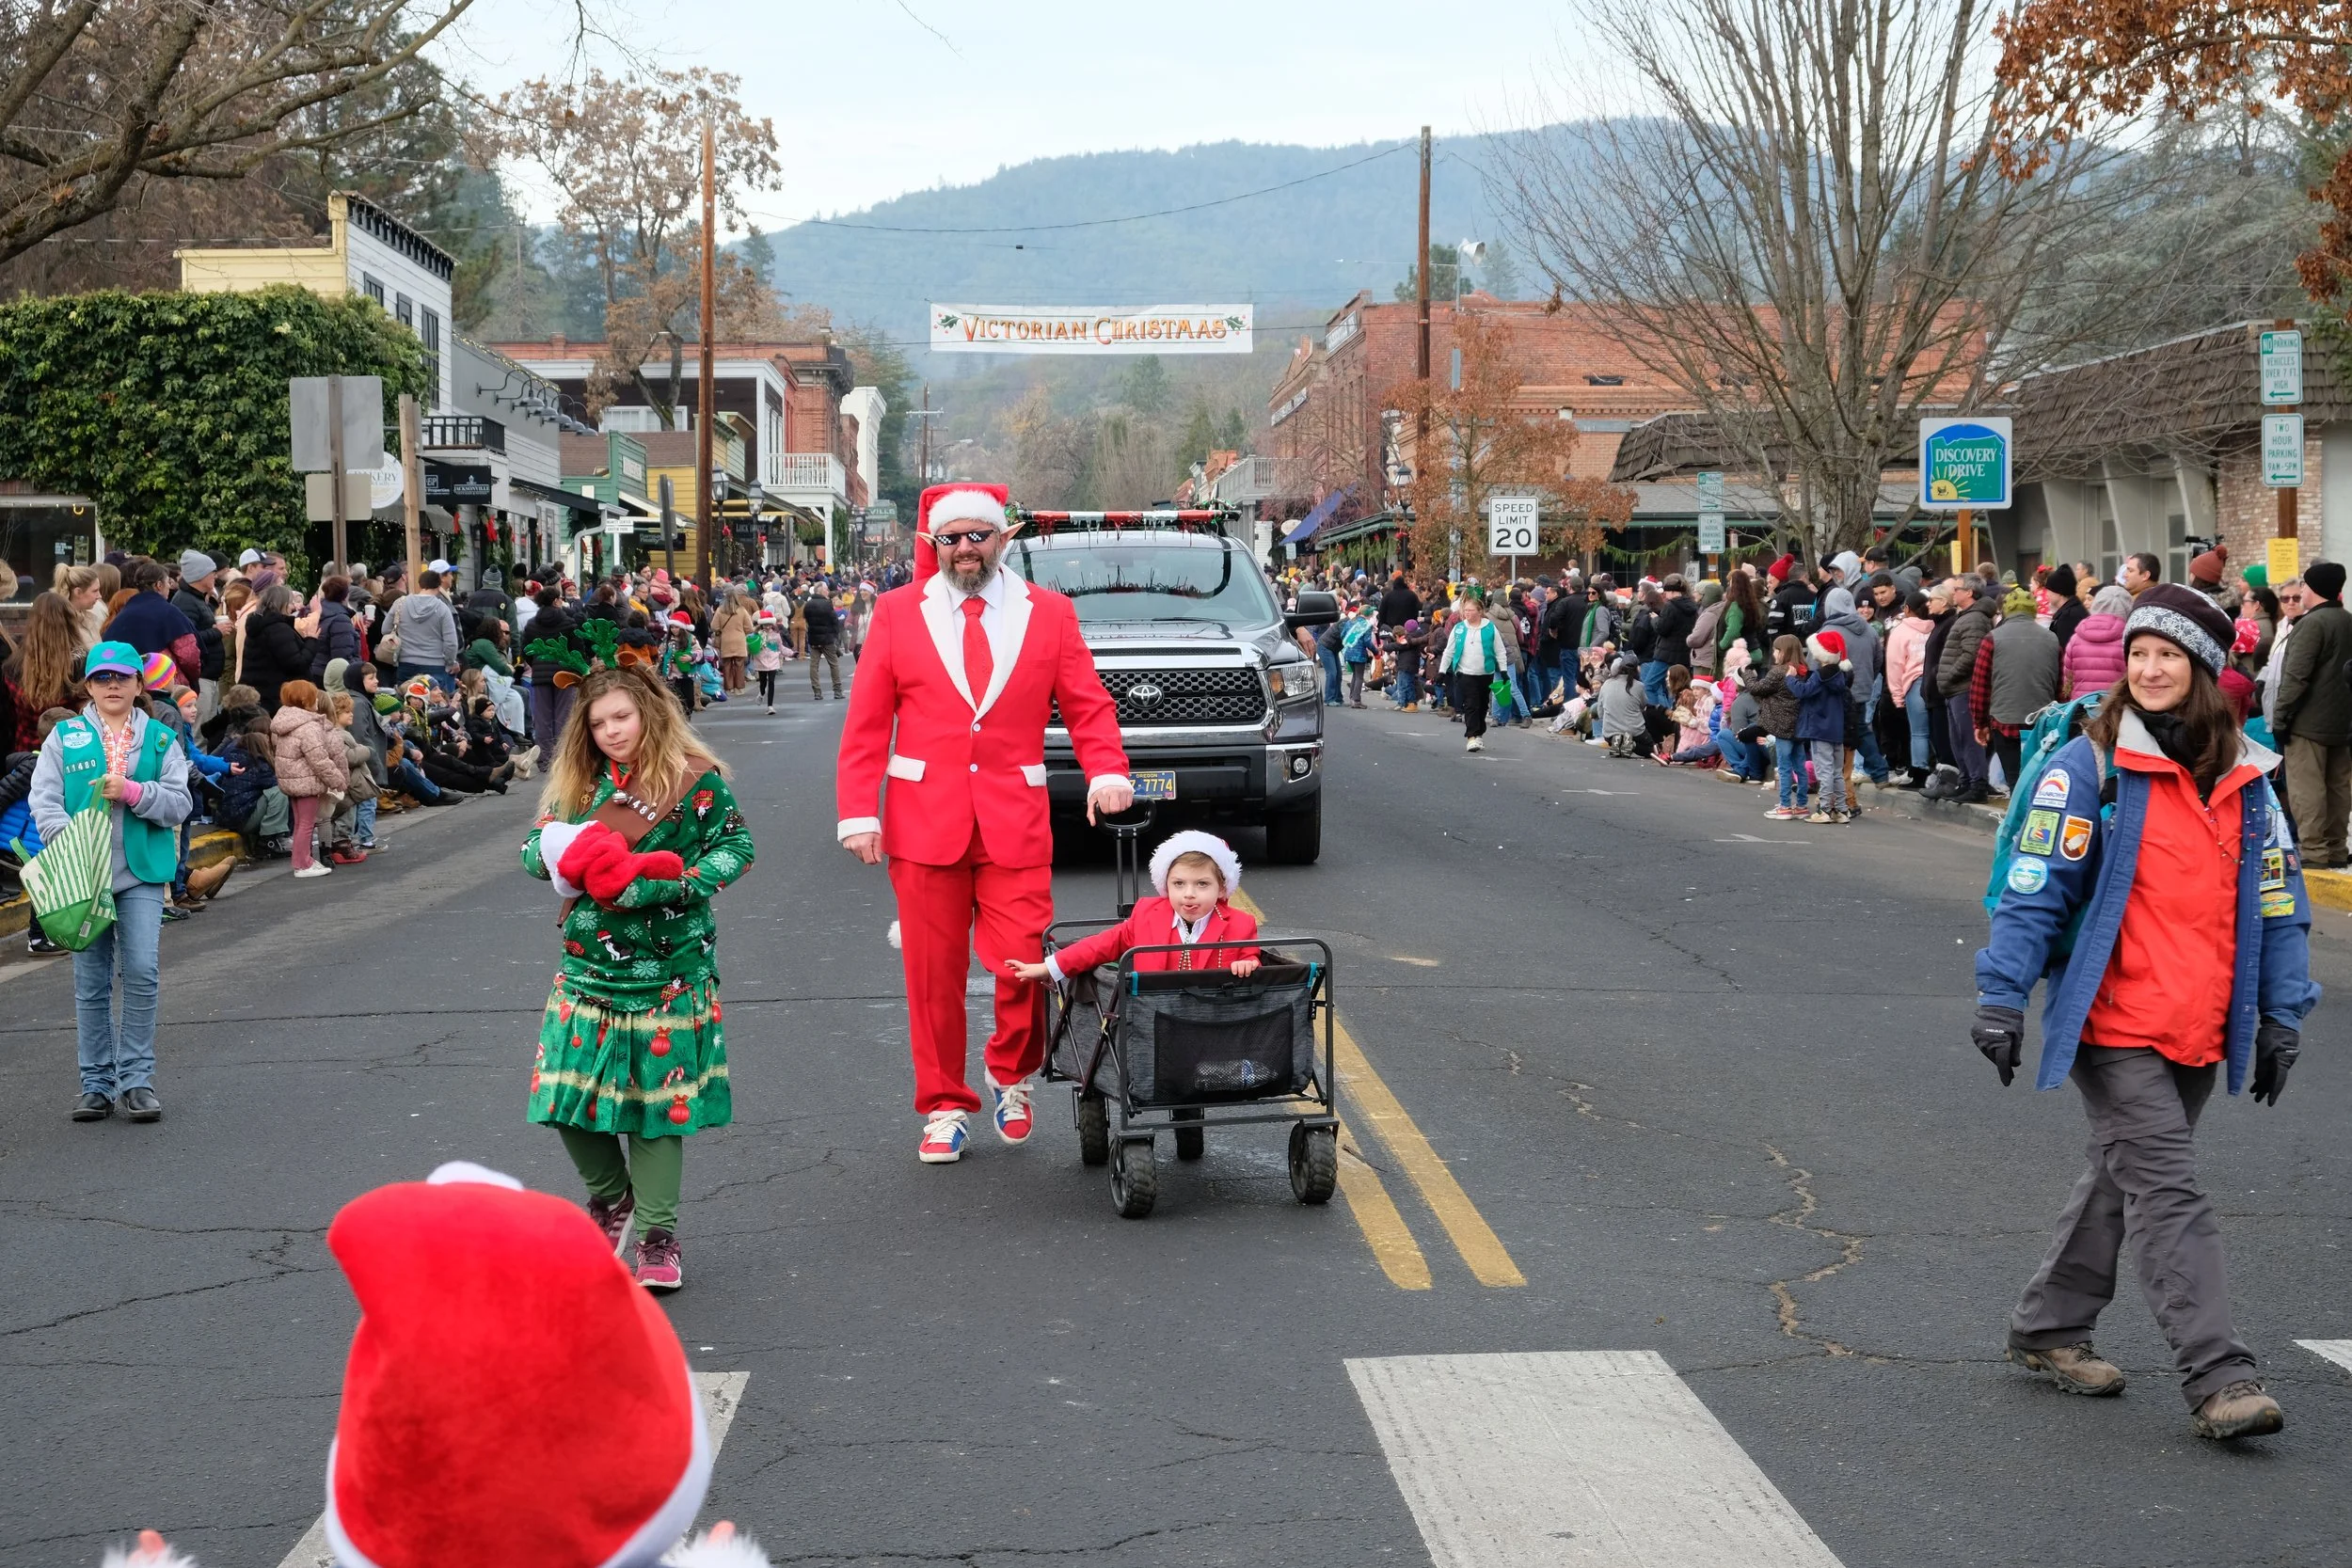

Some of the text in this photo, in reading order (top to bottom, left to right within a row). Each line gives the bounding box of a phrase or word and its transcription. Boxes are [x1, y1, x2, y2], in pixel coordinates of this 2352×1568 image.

[962, 316, 1227, 344] VICTORIAN CHRISTMAS
[2263, 338, 2298, 350] NO PARKING
[2266, 356, 2296, 366] VEHICLES
[2265, 368, 2280, 378] OVER
[2283, 368, 2288, 377] 7
[2273, 379, 2289, 389] HIGH
[2275, 423, 2290, 433] TWO
[2272, 436, 2293, 445] HOUR
[1935, 448, 1997, 462] DISCOVERY
[2267, 449, 2297, 458] PARKING
[1948, 464, 1986, 477] DRIVE
[1495, 503, 1534, 513] SPEED
[1498, 515, 1530, 525] LIMIT
[1496, 528, 1532, 547] 20
[65, 759, 97, 774] 11480
